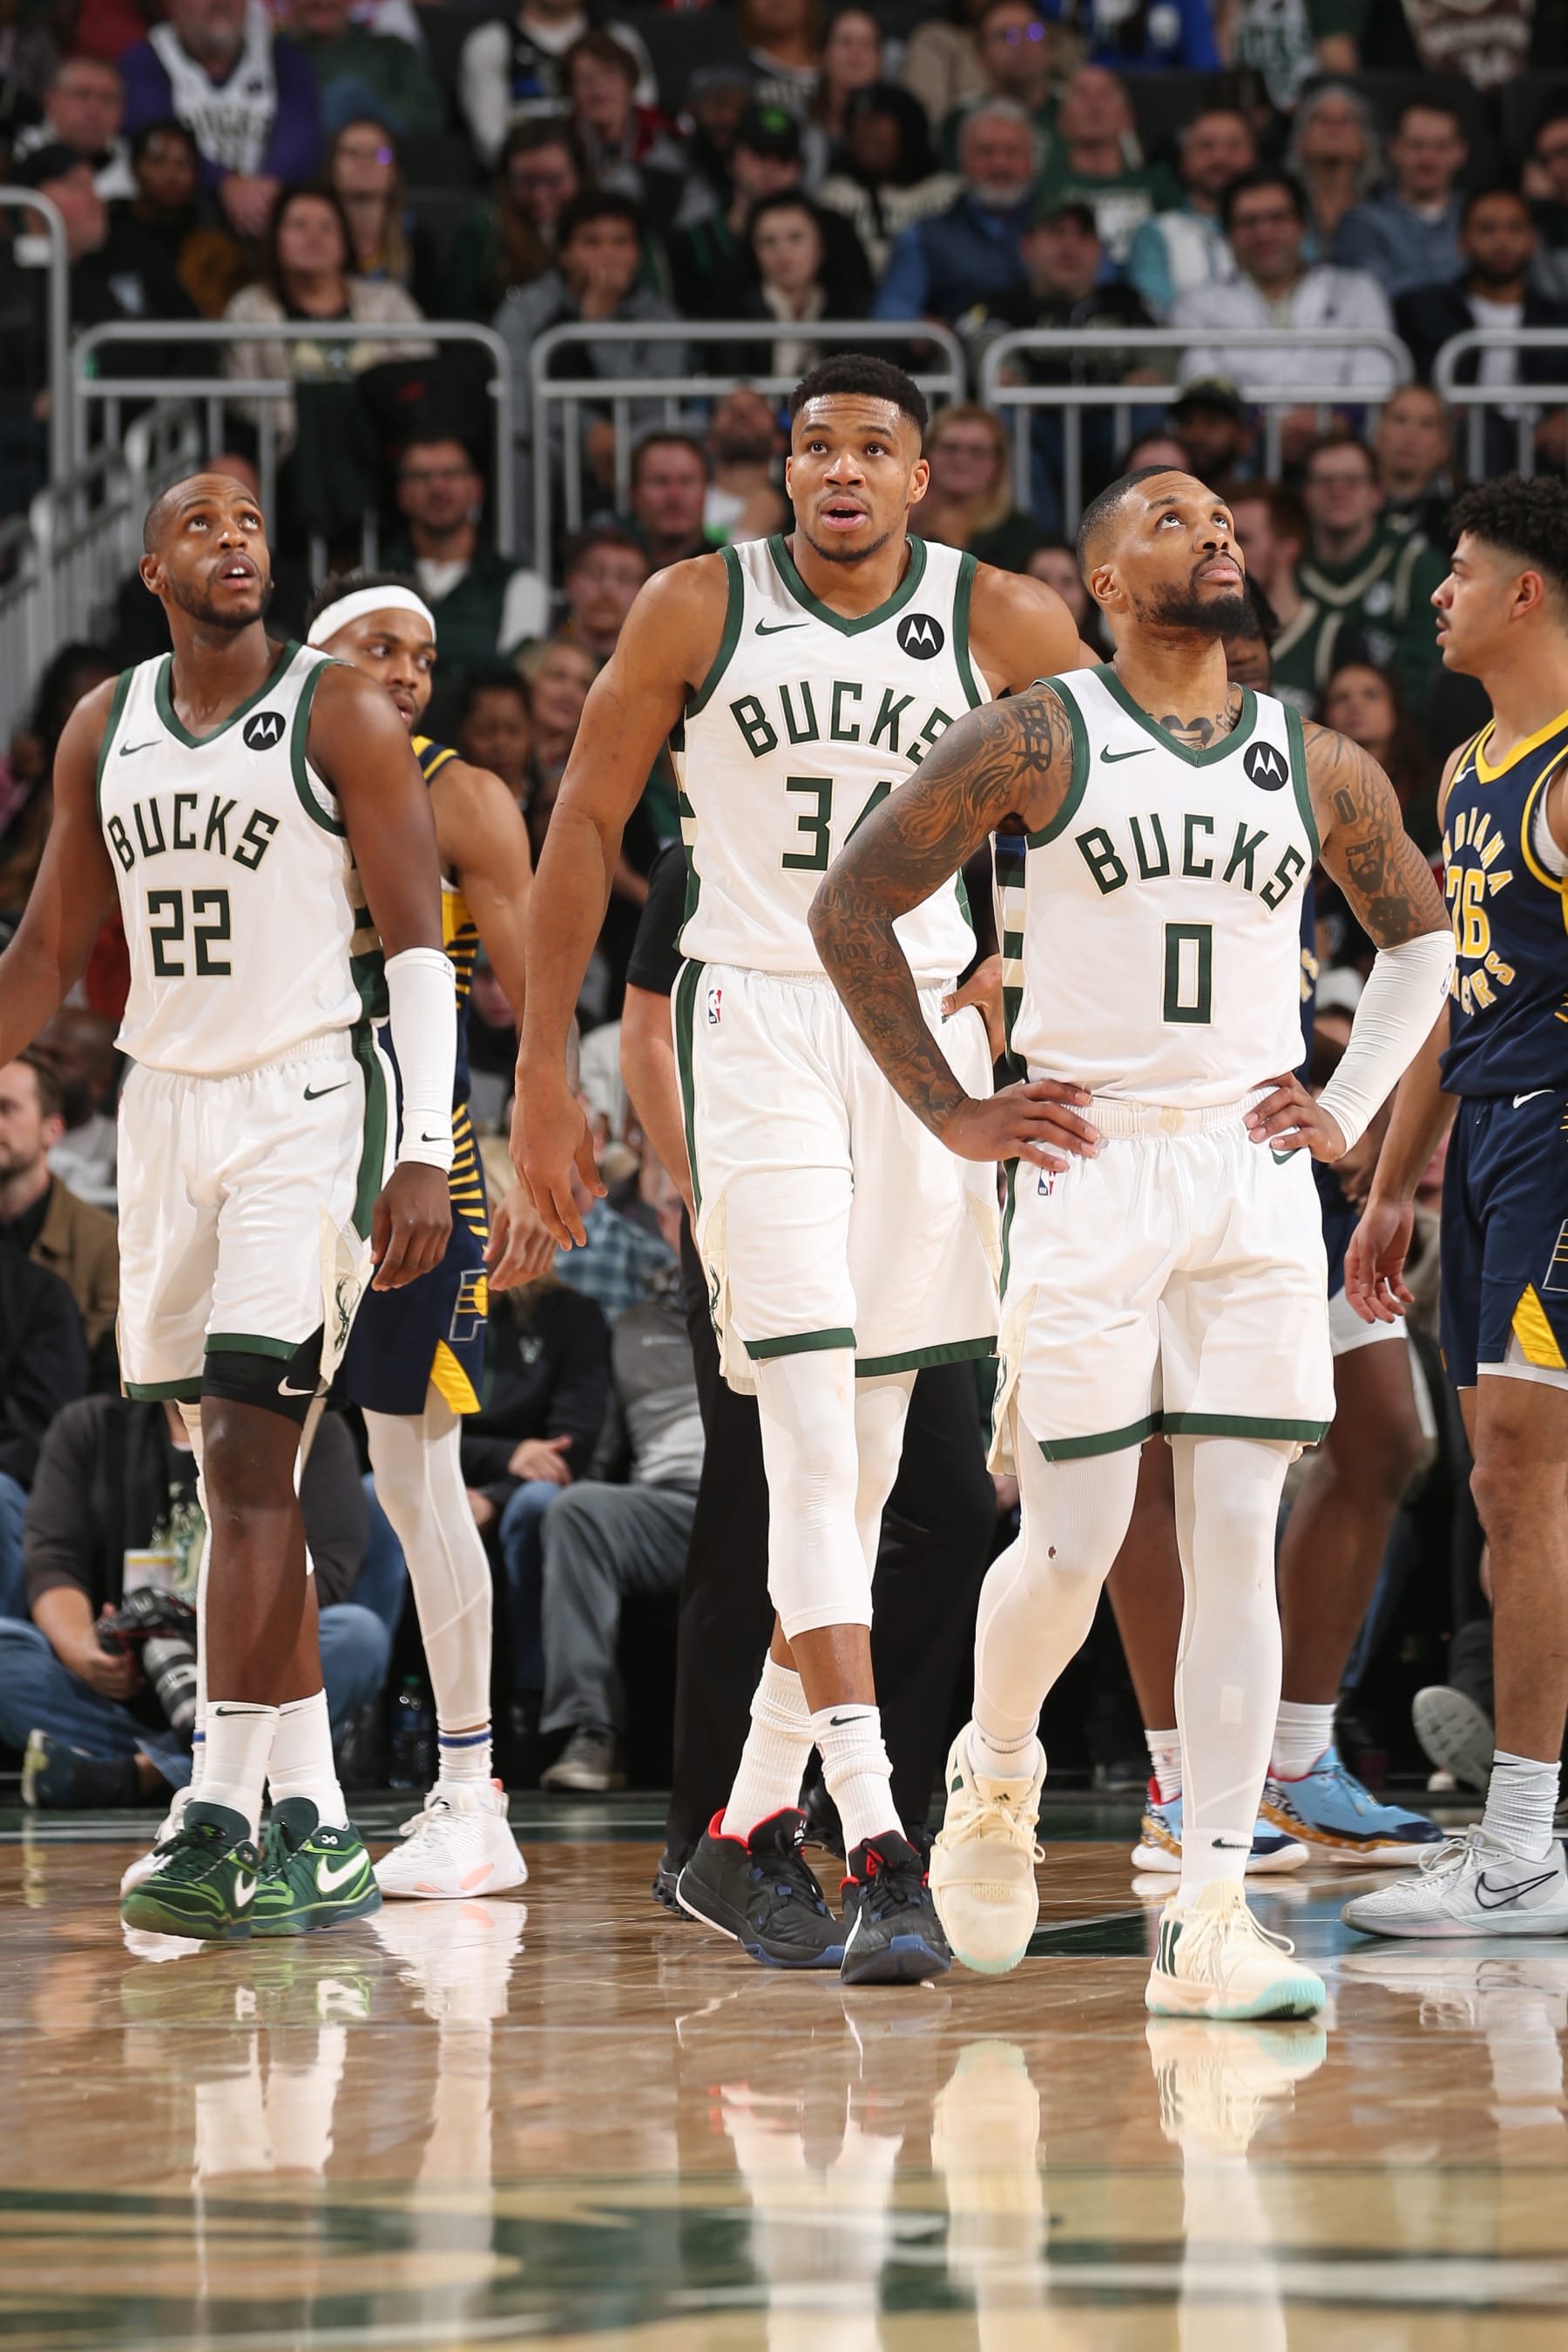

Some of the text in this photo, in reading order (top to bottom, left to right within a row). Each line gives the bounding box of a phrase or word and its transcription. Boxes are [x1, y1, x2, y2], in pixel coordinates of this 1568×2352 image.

[728, 679, 954, 767] BUCKS
[106, 792, 280, 872] BUCKS
[1073, 811, 1307, 912] BUCKS
[145, 887, 233, 977] 22
[1445, 865, 1490, 959] 76
[1162, 921, 1214, 1026] 0
